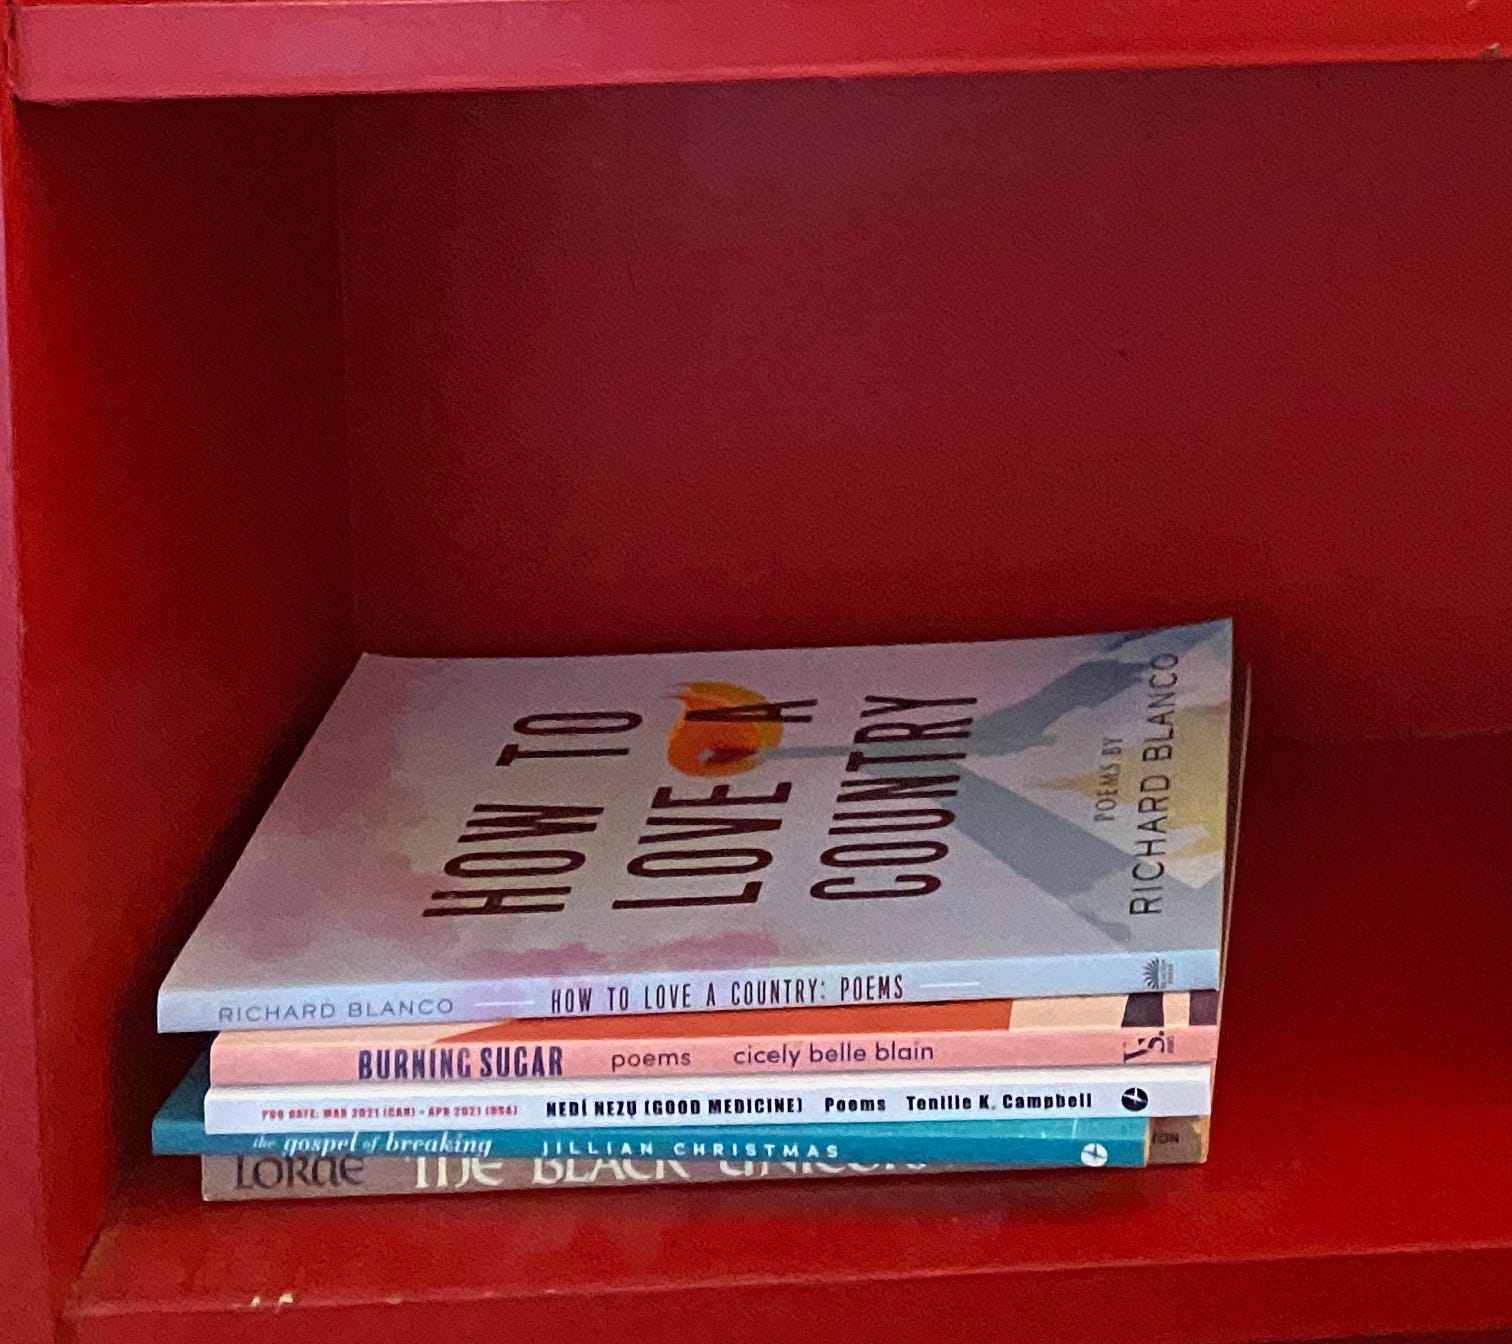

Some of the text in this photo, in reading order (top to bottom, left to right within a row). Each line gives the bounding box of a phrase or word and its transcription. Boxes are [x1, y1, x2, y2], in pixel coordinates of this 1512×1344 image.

[1143, 652, 1179, 762] BLANCO
[423, 712, 643, 917] HOW TO
[810, 694, 977, 901] COUNTRY
[1129, 769, 1170, 915] RICHARD
[359, 1042, 933, 1079] BURNING SUGAR poems cicely belle blain
